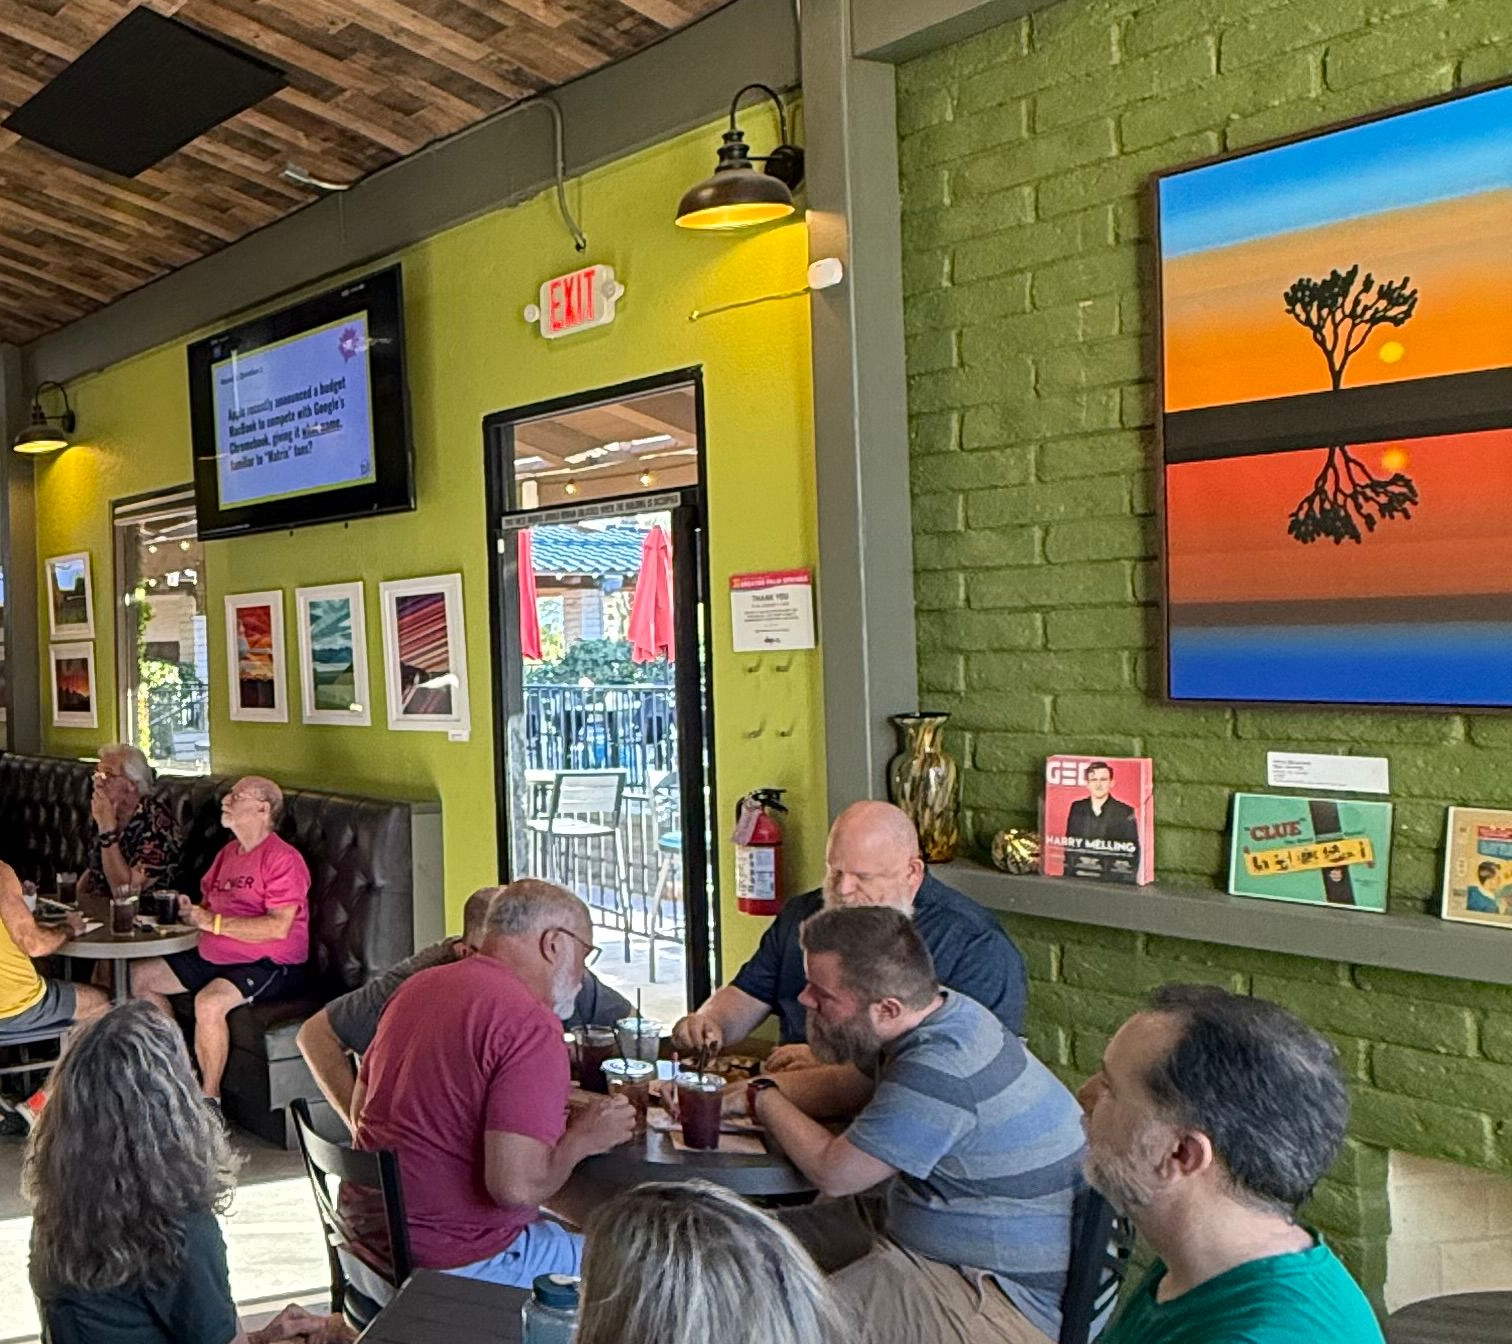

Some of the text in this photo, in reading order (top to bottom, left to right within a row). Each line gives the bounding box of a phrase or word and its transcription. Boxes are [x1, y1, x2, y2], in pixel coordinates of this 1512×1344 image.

[549, 270, 596, 332] EXIT
[275, 385, 312, 408] announced
[319, 376, 346, 395] budget
[229, 398, 345, 437] MacBook to compete with Google's
[272, 429, 293, 447] giving
[295, 427, 300, 438] it
[256, 455, 263, 466] to
[293, 441, 313, 456] fans?
[1046, 834, 1136, 853] HARRY MELLING
